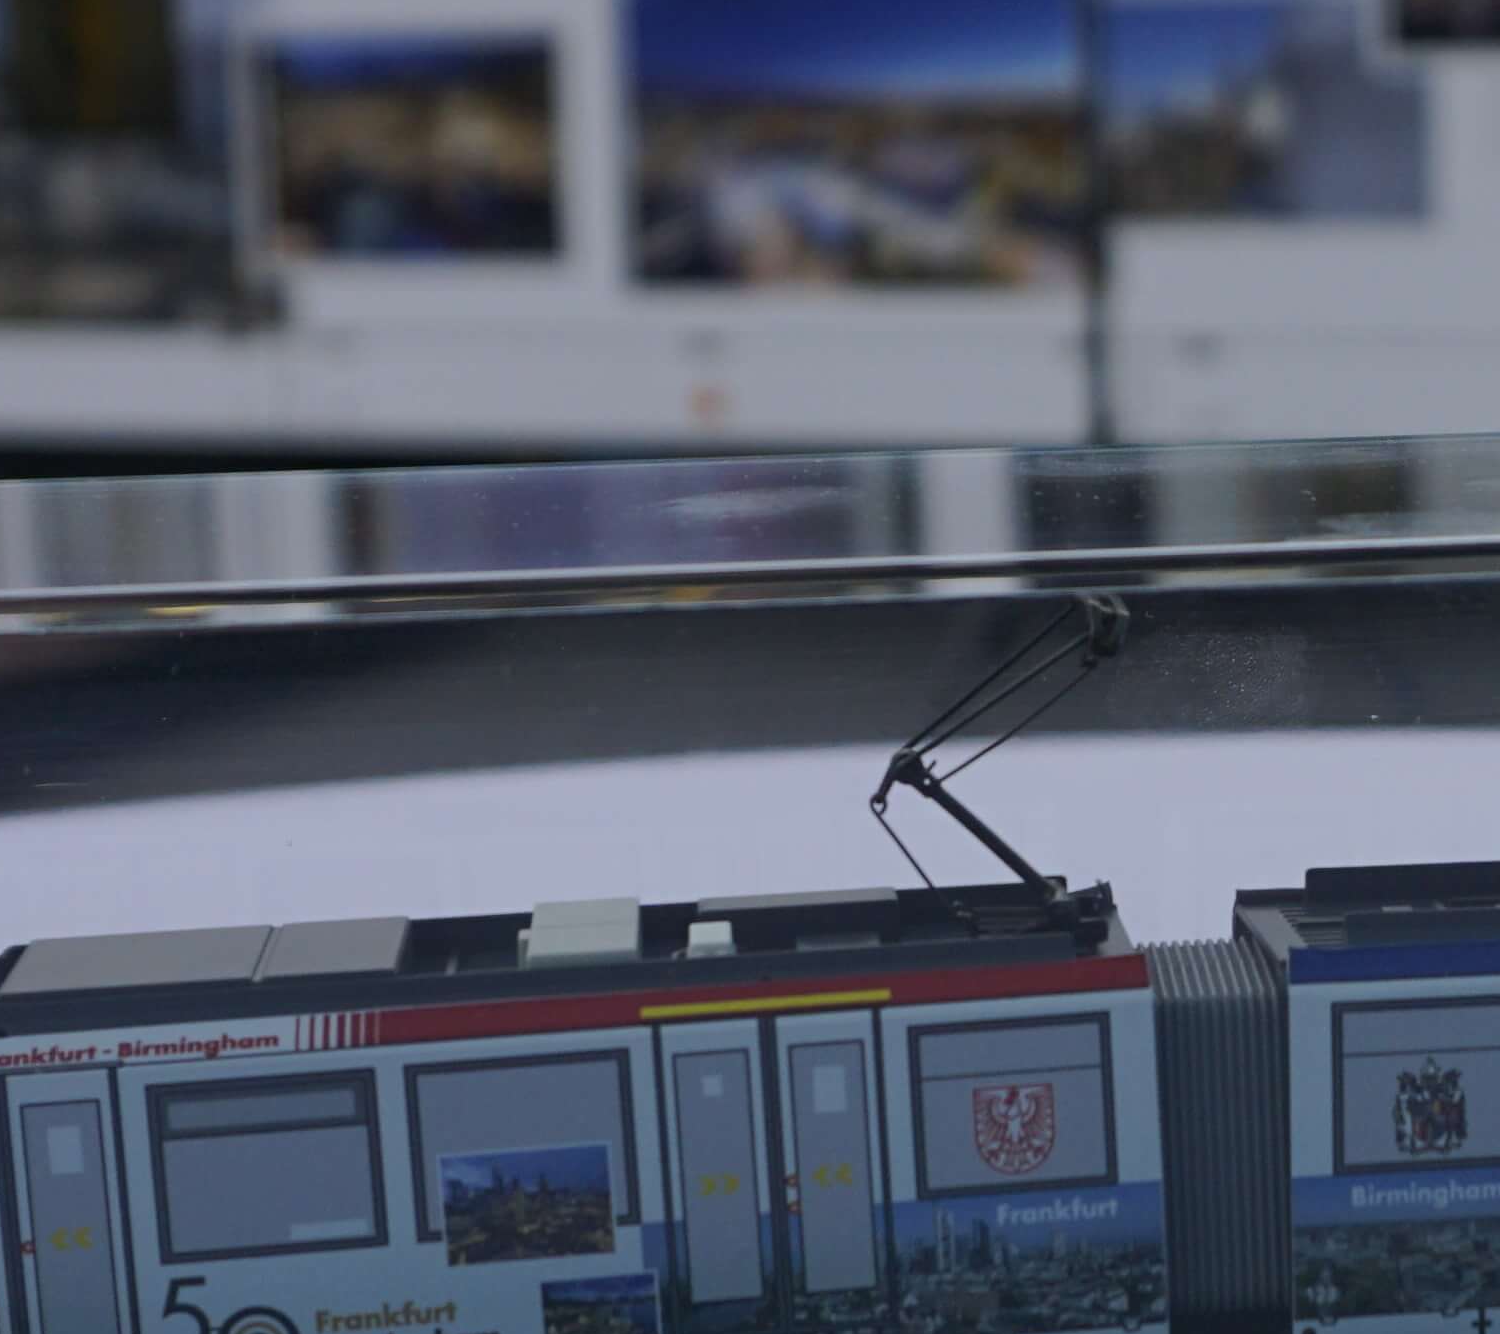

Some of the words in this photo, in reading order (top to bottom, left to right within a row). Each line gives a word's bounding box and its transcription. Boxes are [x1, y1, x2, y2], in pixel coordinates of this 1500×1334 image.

[117, 1033, 280, 1060] Birmingham
[996, 1195, 1119, 1226] Frankfurt
[315, 1299, 457, 1334] Frankfurt
